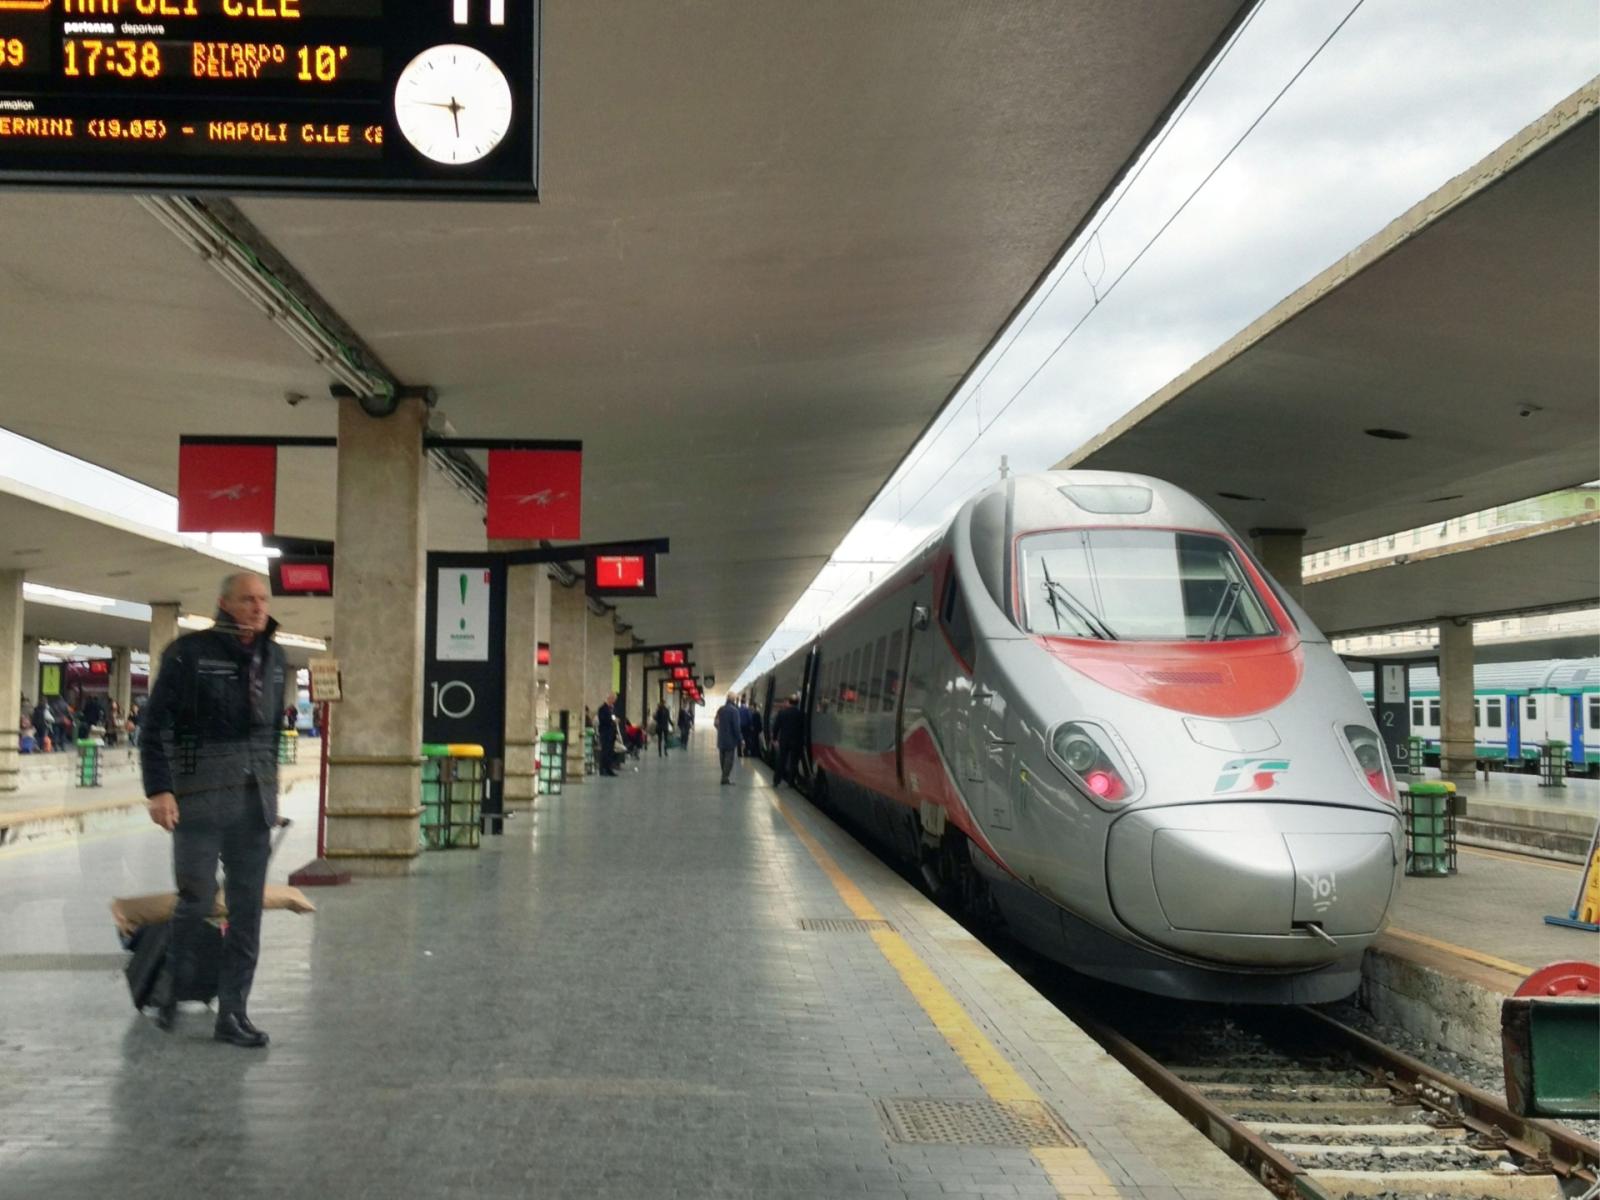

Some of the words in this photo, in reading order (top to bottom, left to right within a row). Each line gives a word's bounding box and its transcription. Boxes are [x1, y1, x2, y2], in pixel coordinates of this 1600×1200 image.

[0, 38, 24, 66] 9
[64, 40, 161, 77] 17:38
[193, 42, 285, 63] RITARDO
[193, 58, 262, 78] DELAY
[88, 118, 167, 139] (19.05)
[209, 121, 288, 142] NAPOLI
[301, 123, 350, 143] C.LE
[431, 680, 475, 719] 10
